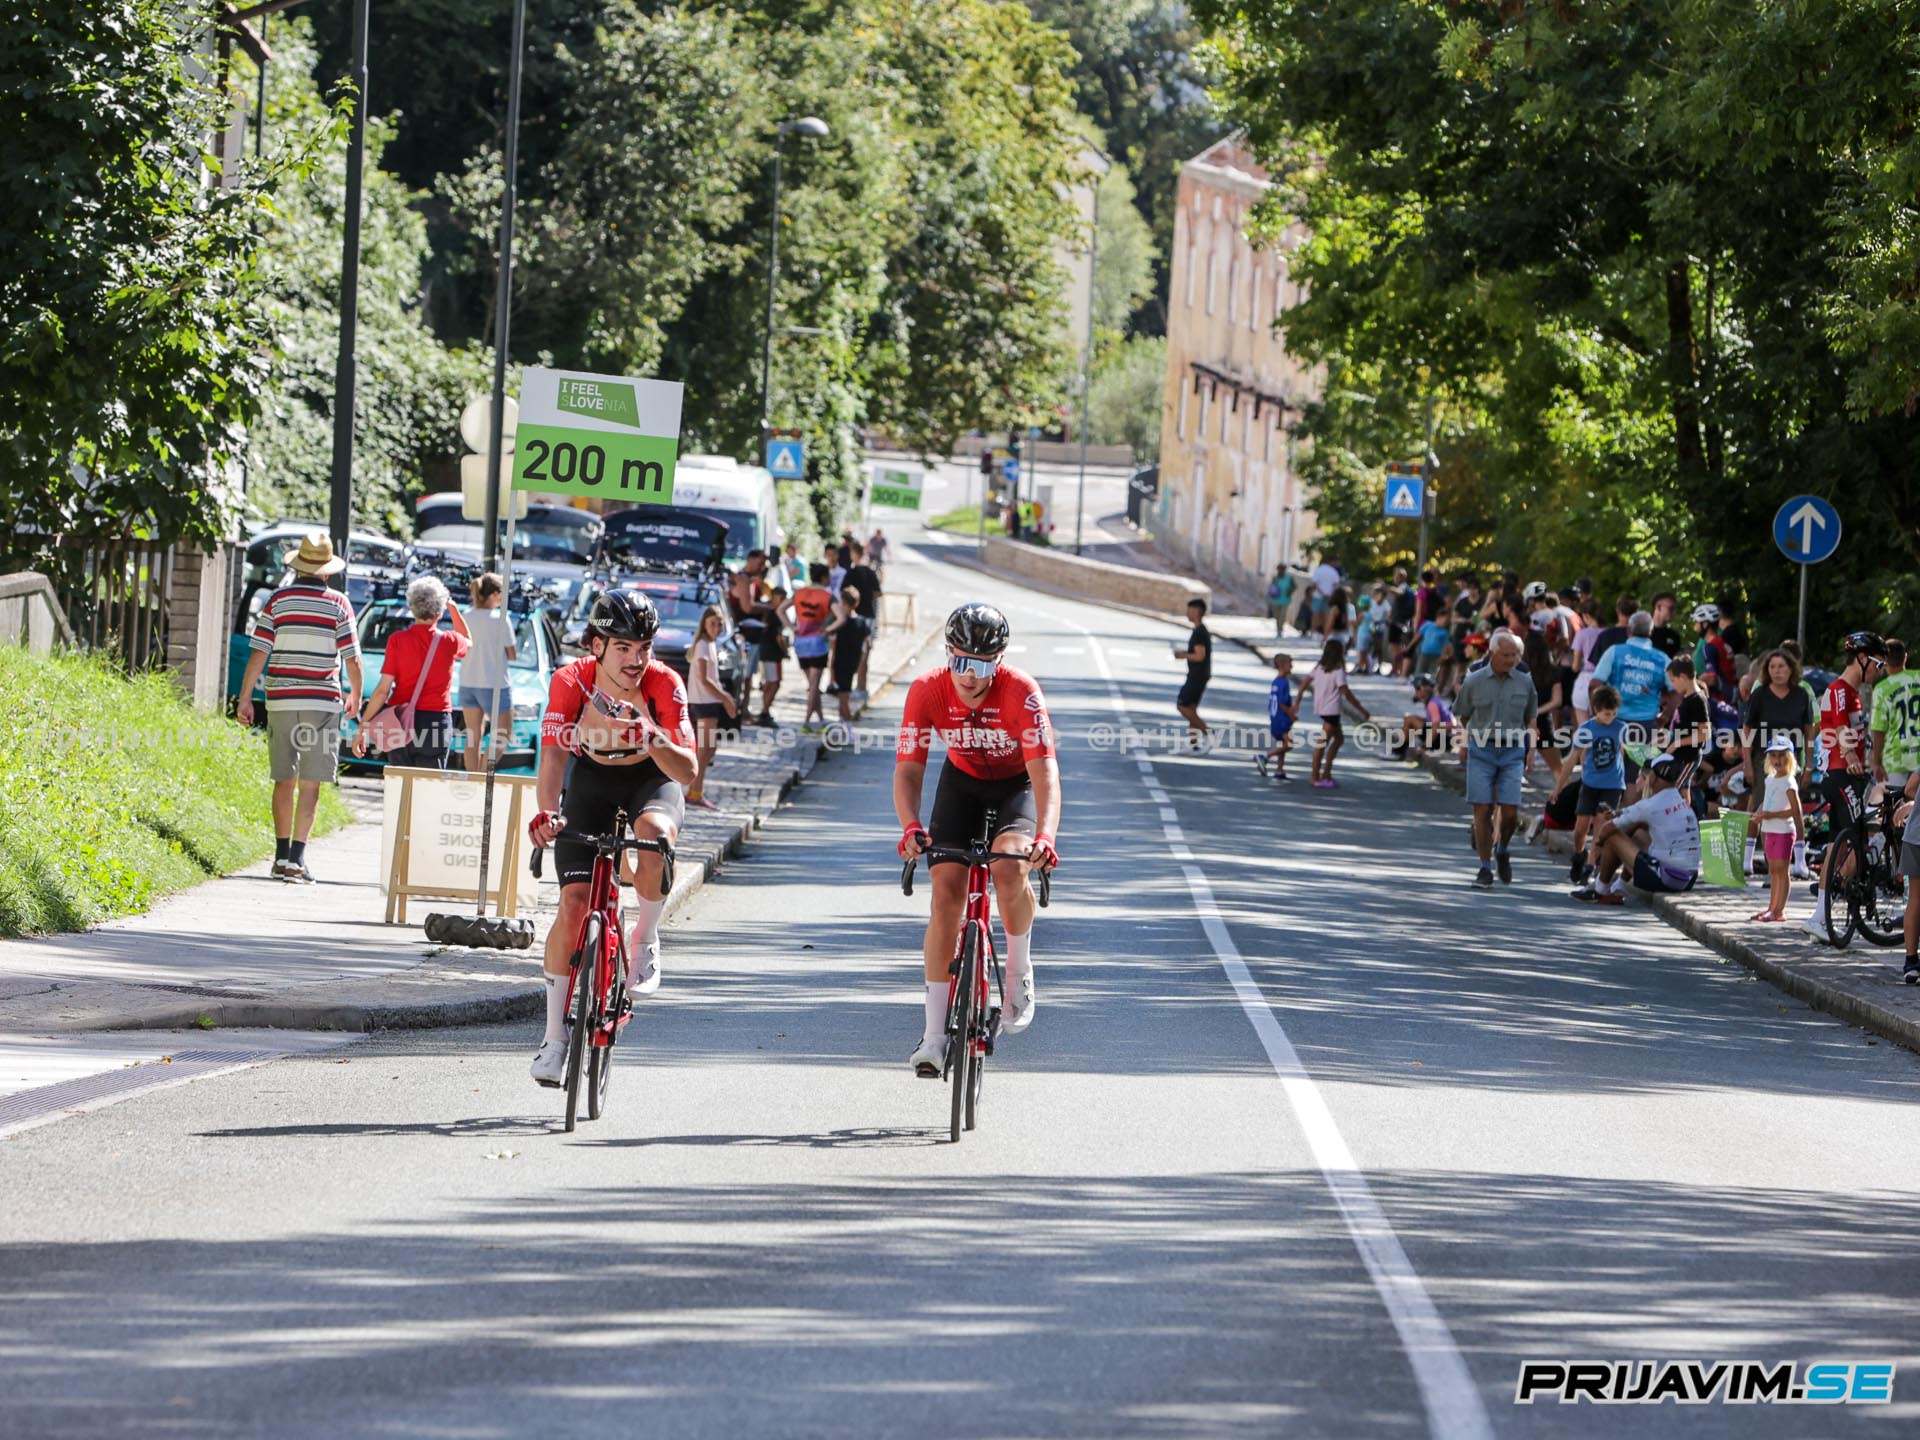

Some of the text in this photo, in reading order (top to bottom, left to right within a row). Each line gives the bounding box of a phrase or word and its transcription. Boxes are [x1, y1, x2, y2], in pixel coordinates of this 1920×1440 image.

[561, 381, 602, 397] I FEEL
[561, 394, 627, 412] SLOVENIA
[523, 440, 664, 492] 200 m
[944, 727, 1009, 743] PIERRE
